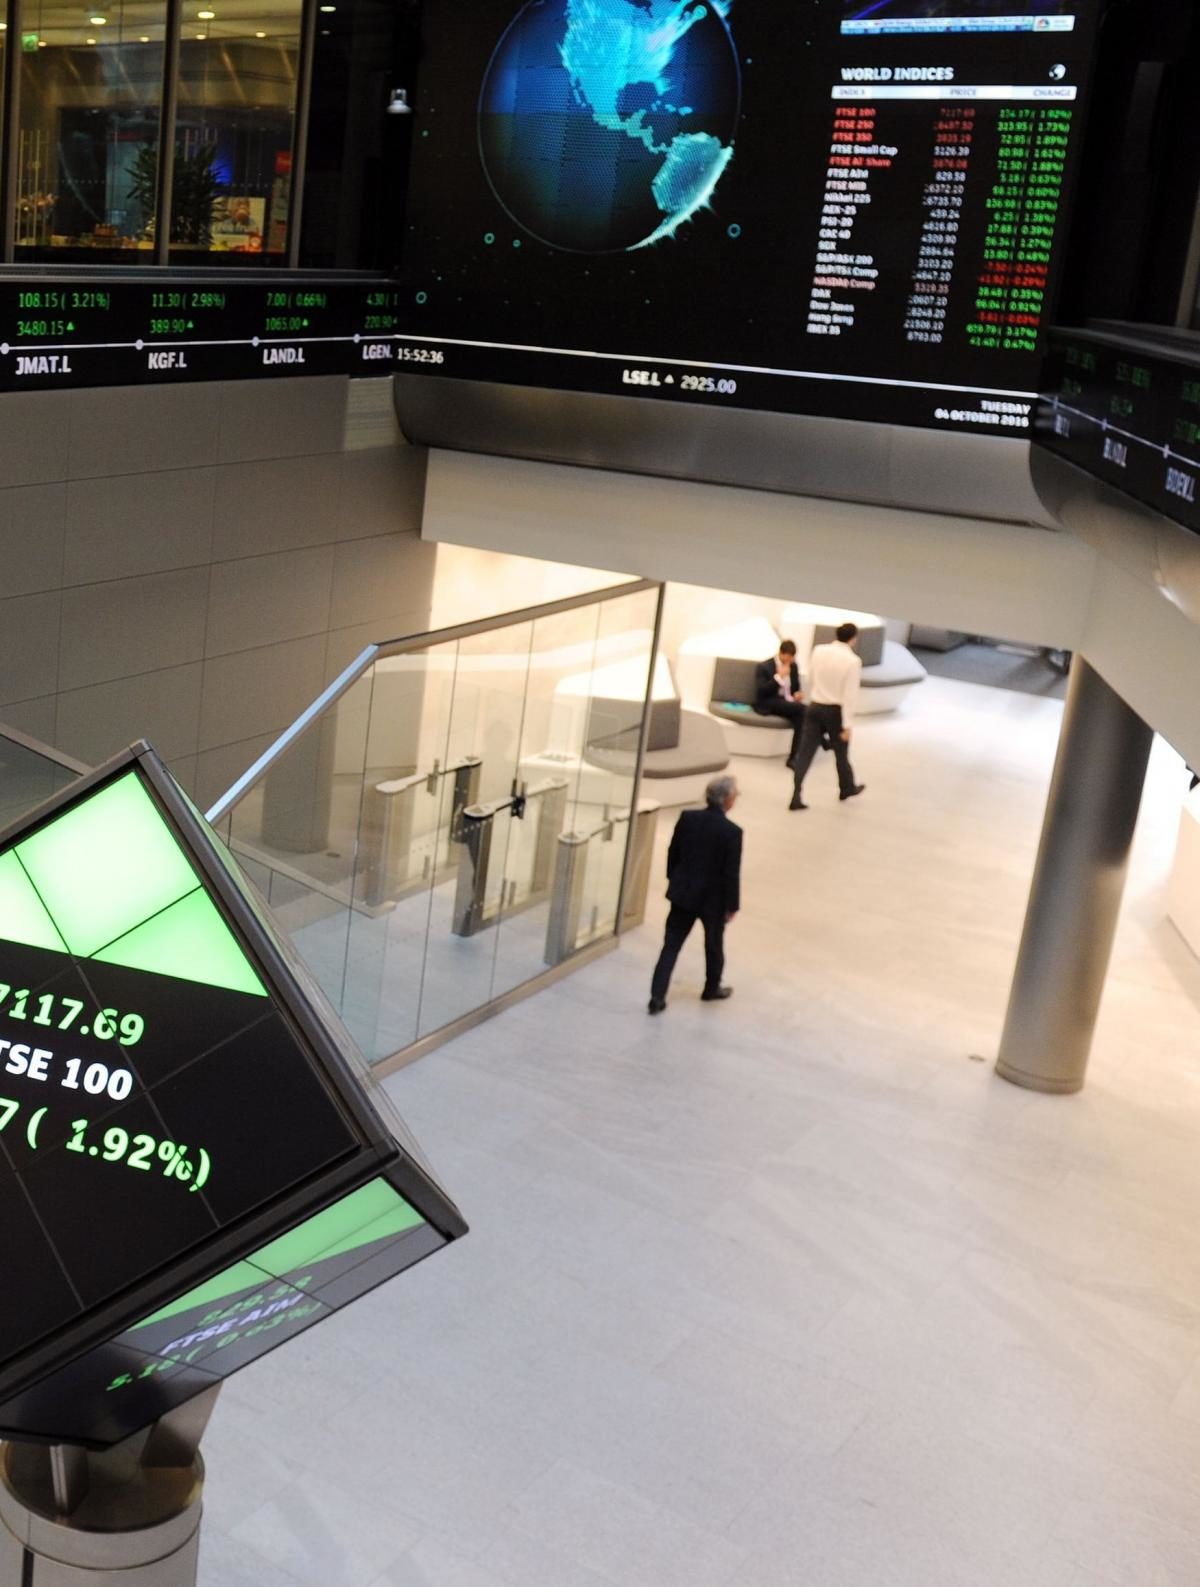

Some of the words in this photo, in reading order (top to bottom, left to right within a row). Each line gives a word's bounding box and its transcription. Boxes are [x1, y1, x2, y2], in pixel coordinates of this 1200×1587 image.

[841, 67, 892, 81] WORLD
[893, 67, 954, 81] INDICES
[16, 321, 65, 336] 3480.15
[148, 352, 187, 370] KGF.L
[263, 348, 306, 364] LAND.L
[15, 356, 72, 376] JMAT.L
[680, 374, 737, 394] 2925.00
[980, 399, 1031, 416] TUESDAY
[950, 408, 999, 425] OCTOBER
[999, 413, 1029, 428] 2016
[61, 1057, 134, 1101] 100
[65, 1118, 211, 1193] 1.92%)
